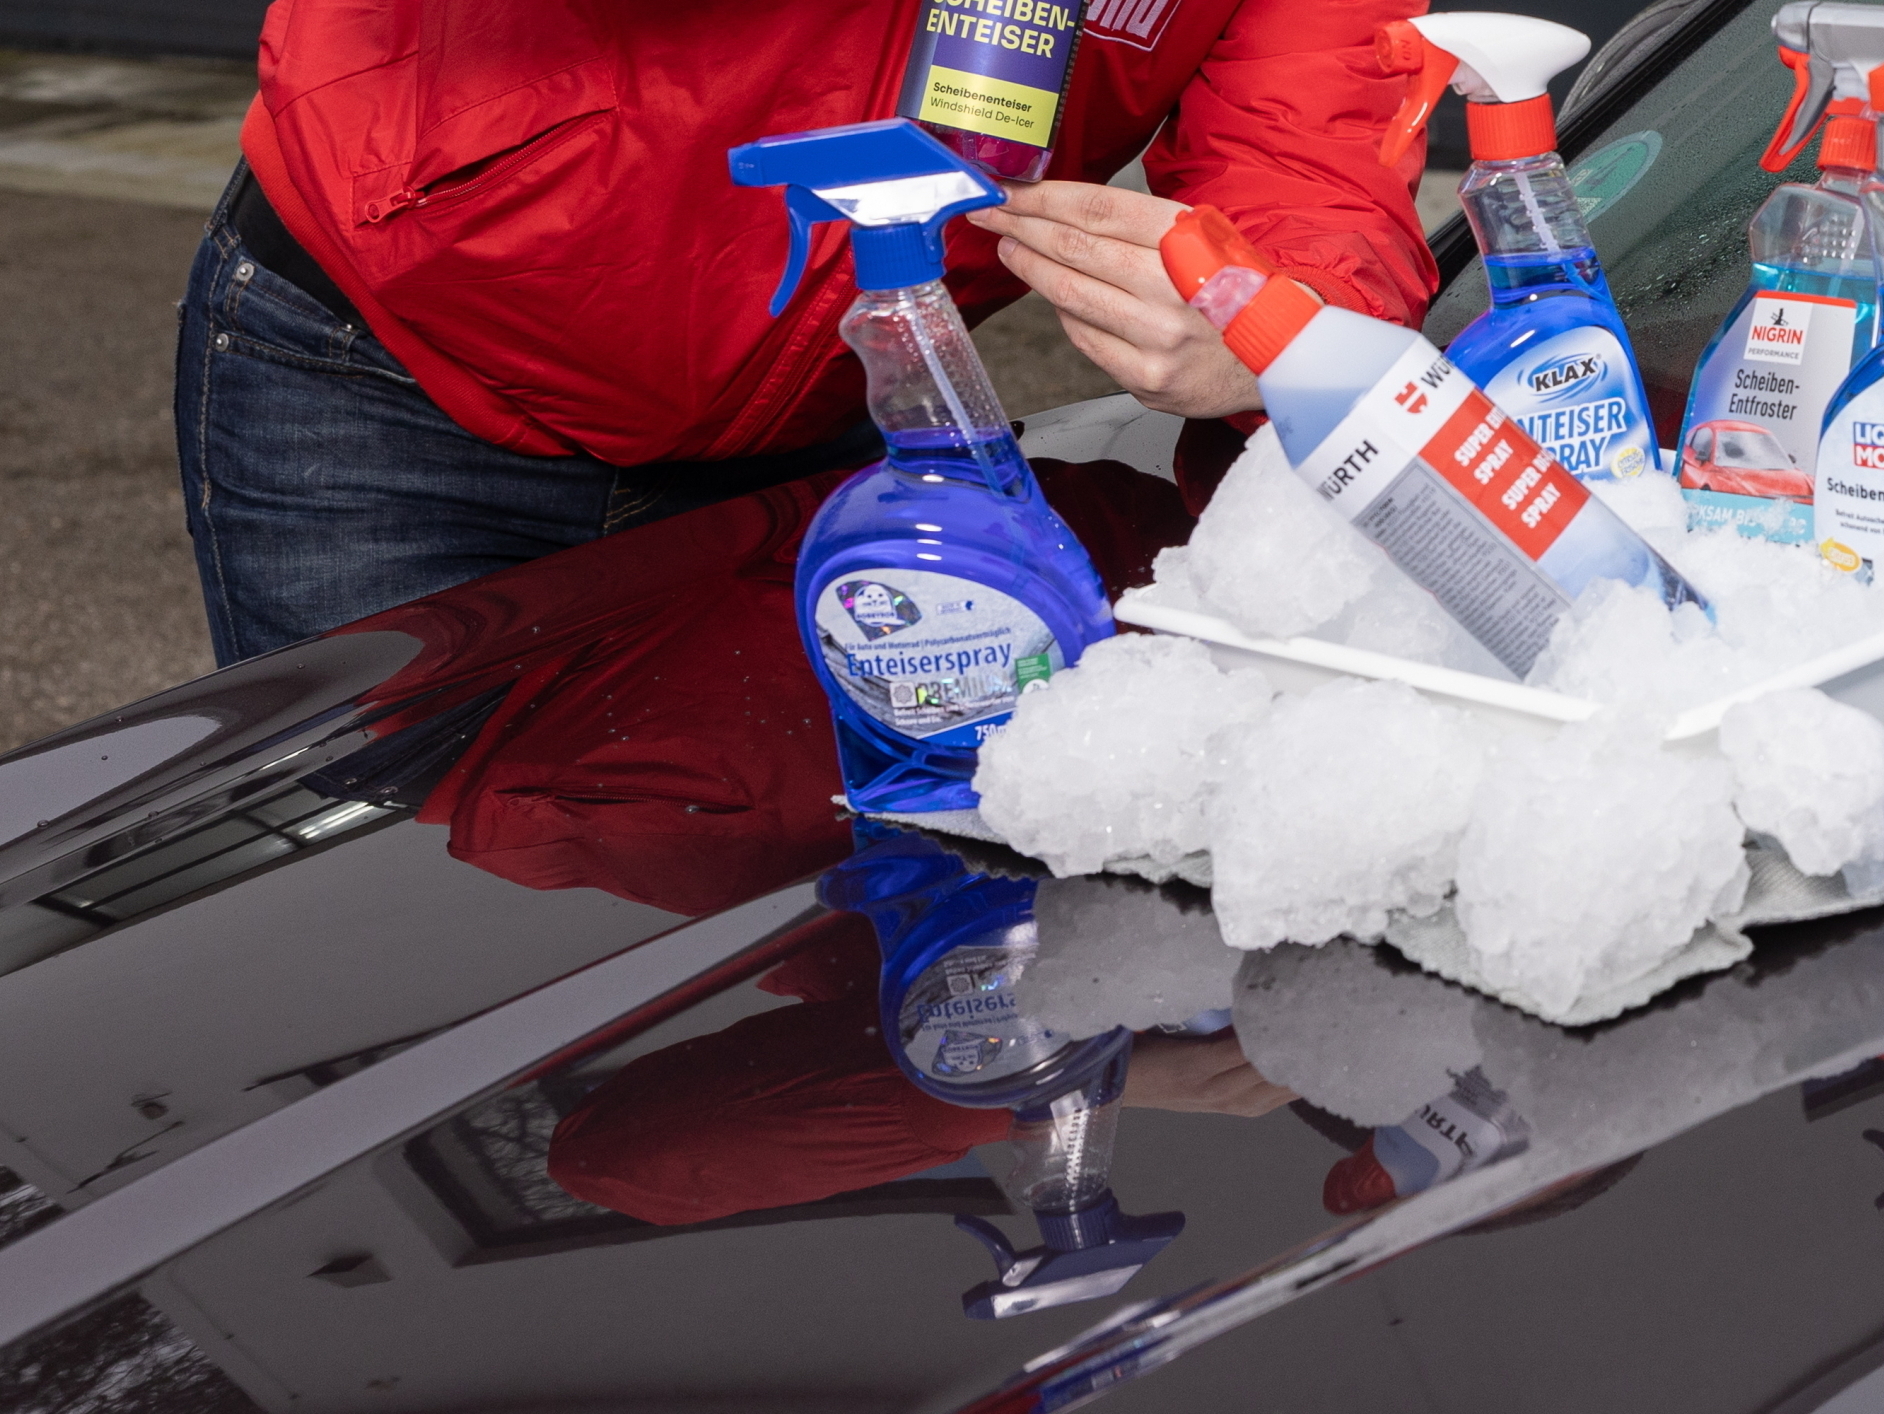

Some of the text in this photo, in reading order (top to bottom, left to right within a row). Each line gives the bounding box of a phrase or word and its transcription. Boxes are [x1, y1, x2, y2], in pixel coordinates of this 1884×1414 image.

[926, 7, 1055, 59] ENTEISER
[930, 96, 1035, 129] Windshield De-Icer
[932, 81, 1033, 114] Scheibenenteiser
[1751, 325, 1803, 345] NIGRIN
[1747, 347, 1800, 361] PERFORMANCE
[1534, 357, 1597, 392] KLAX
[1734, 368, 1800, 394] Scheiben-
[1517, 400, 1623, 444] NTEISER
[1728, 393, 1798, 421] Entfroster
[1454, 422, 1495, 467] SUPER
[1474, 438, 1513, 485] SPRAY
[1501, 466, 1543, 511] SUPER
[1521, 482, 1561, 528] SPRAY
[1697, 504, 1733, 522] KSAM
[848, 642, 1011, 678] Enteiserspray
